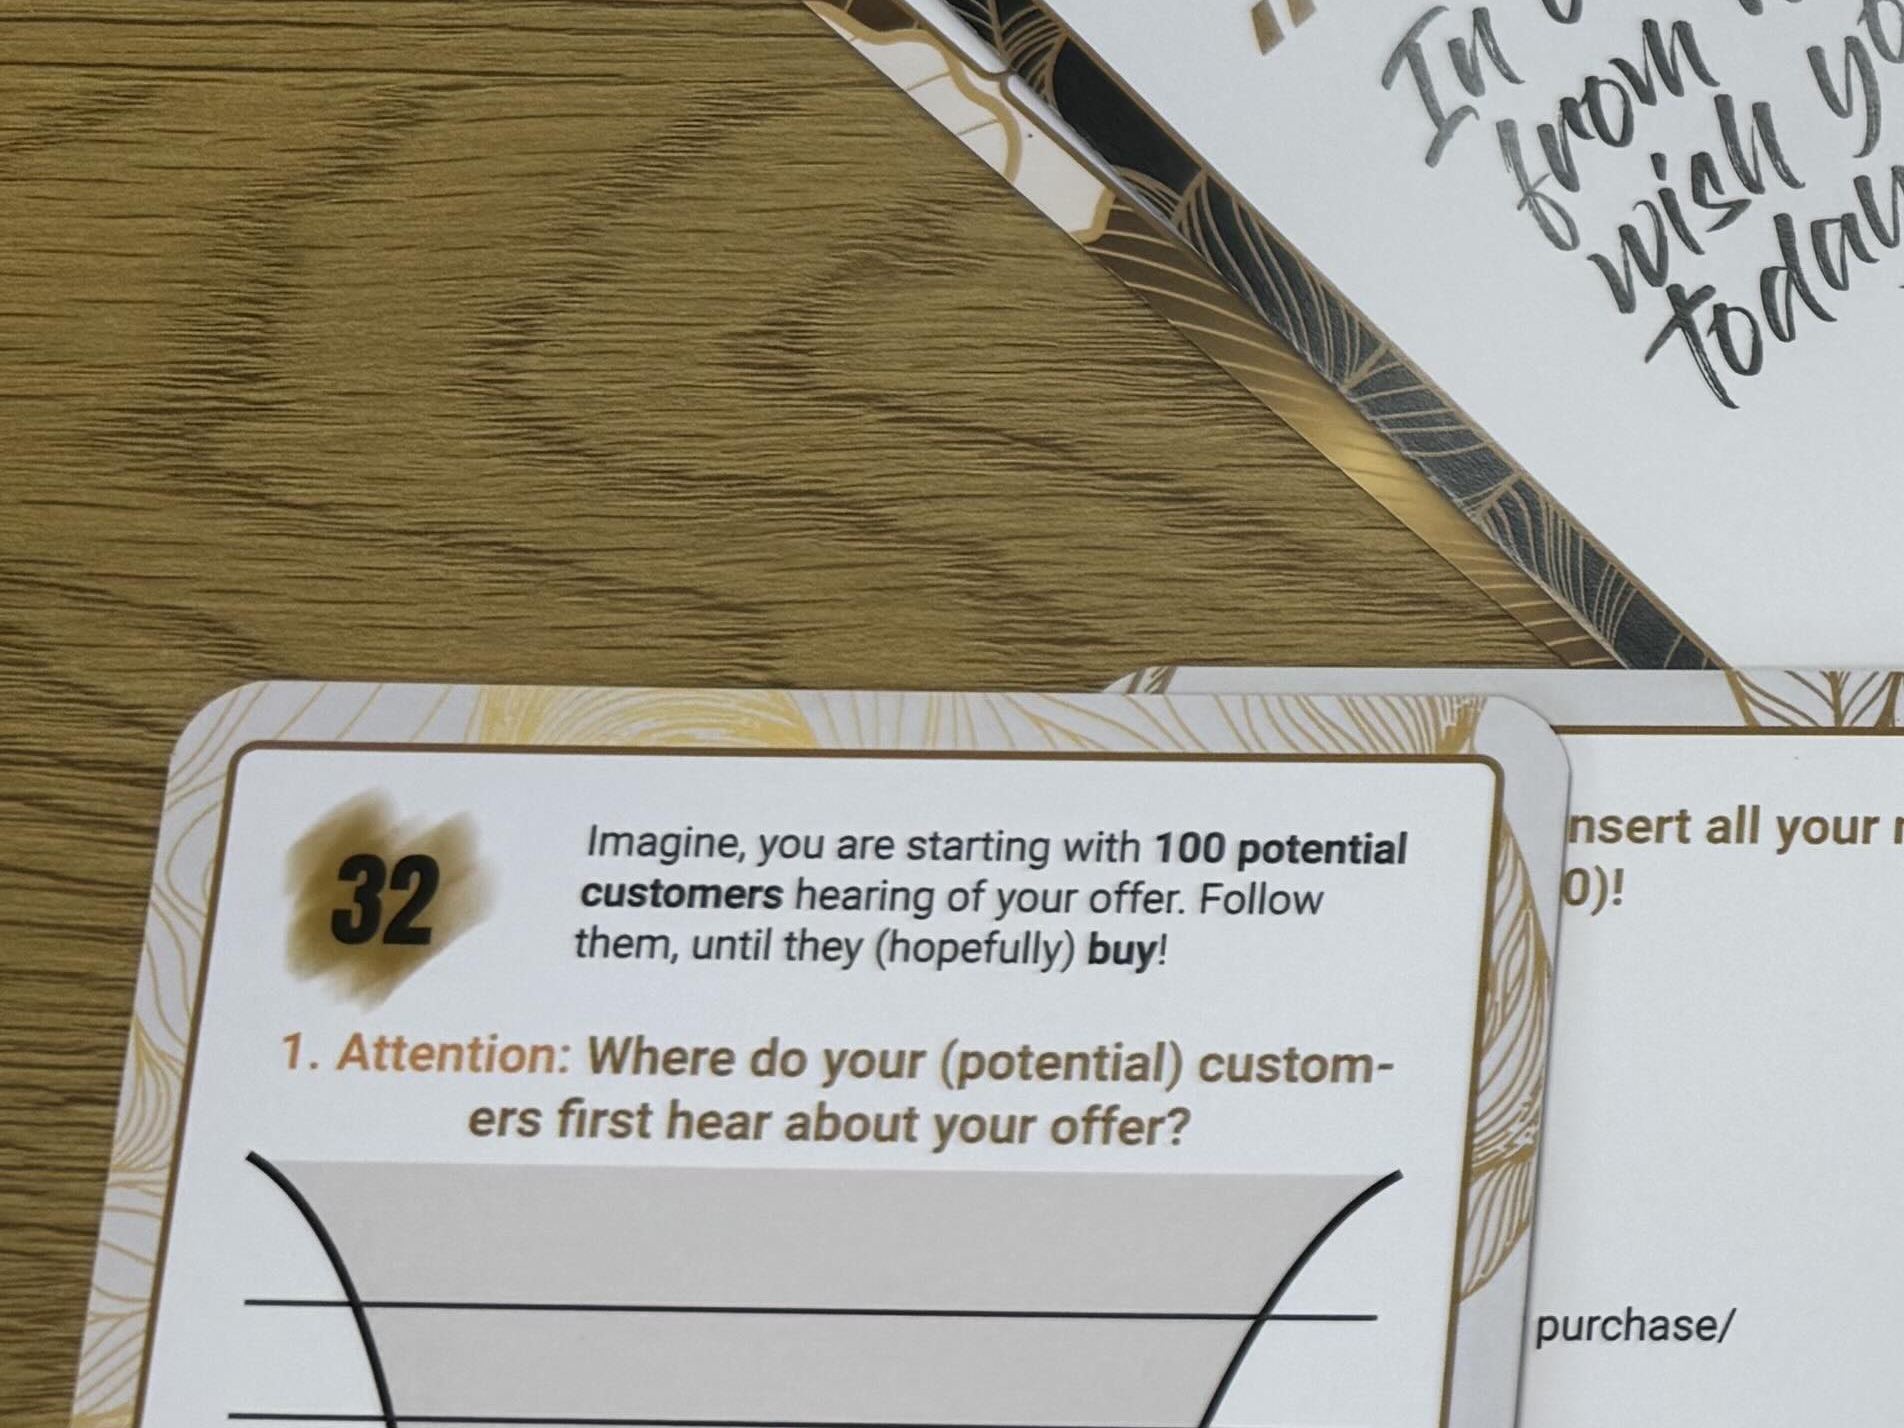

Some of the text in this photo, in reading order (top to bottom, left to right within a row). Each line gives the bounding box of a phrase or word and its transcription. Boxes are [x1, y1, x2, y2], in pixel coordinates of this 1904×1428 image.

[1380, 6, 1526, 169] In
[1498, 19, 1719, 251] from
[1589, 93, 1803, 314] wish
[587, 824, 1408, 872] Imagine, you are starting with 100 potential
[1705, 804, 1761, 845] all
[1775, 815, 1881, 856] your
[330, 853, 440, 946] 32
[282, 1031, 1394, 1093] 1. Attention: Where do your (potential) custom-
[1535, 1305, 1737, 1350] purchase/
